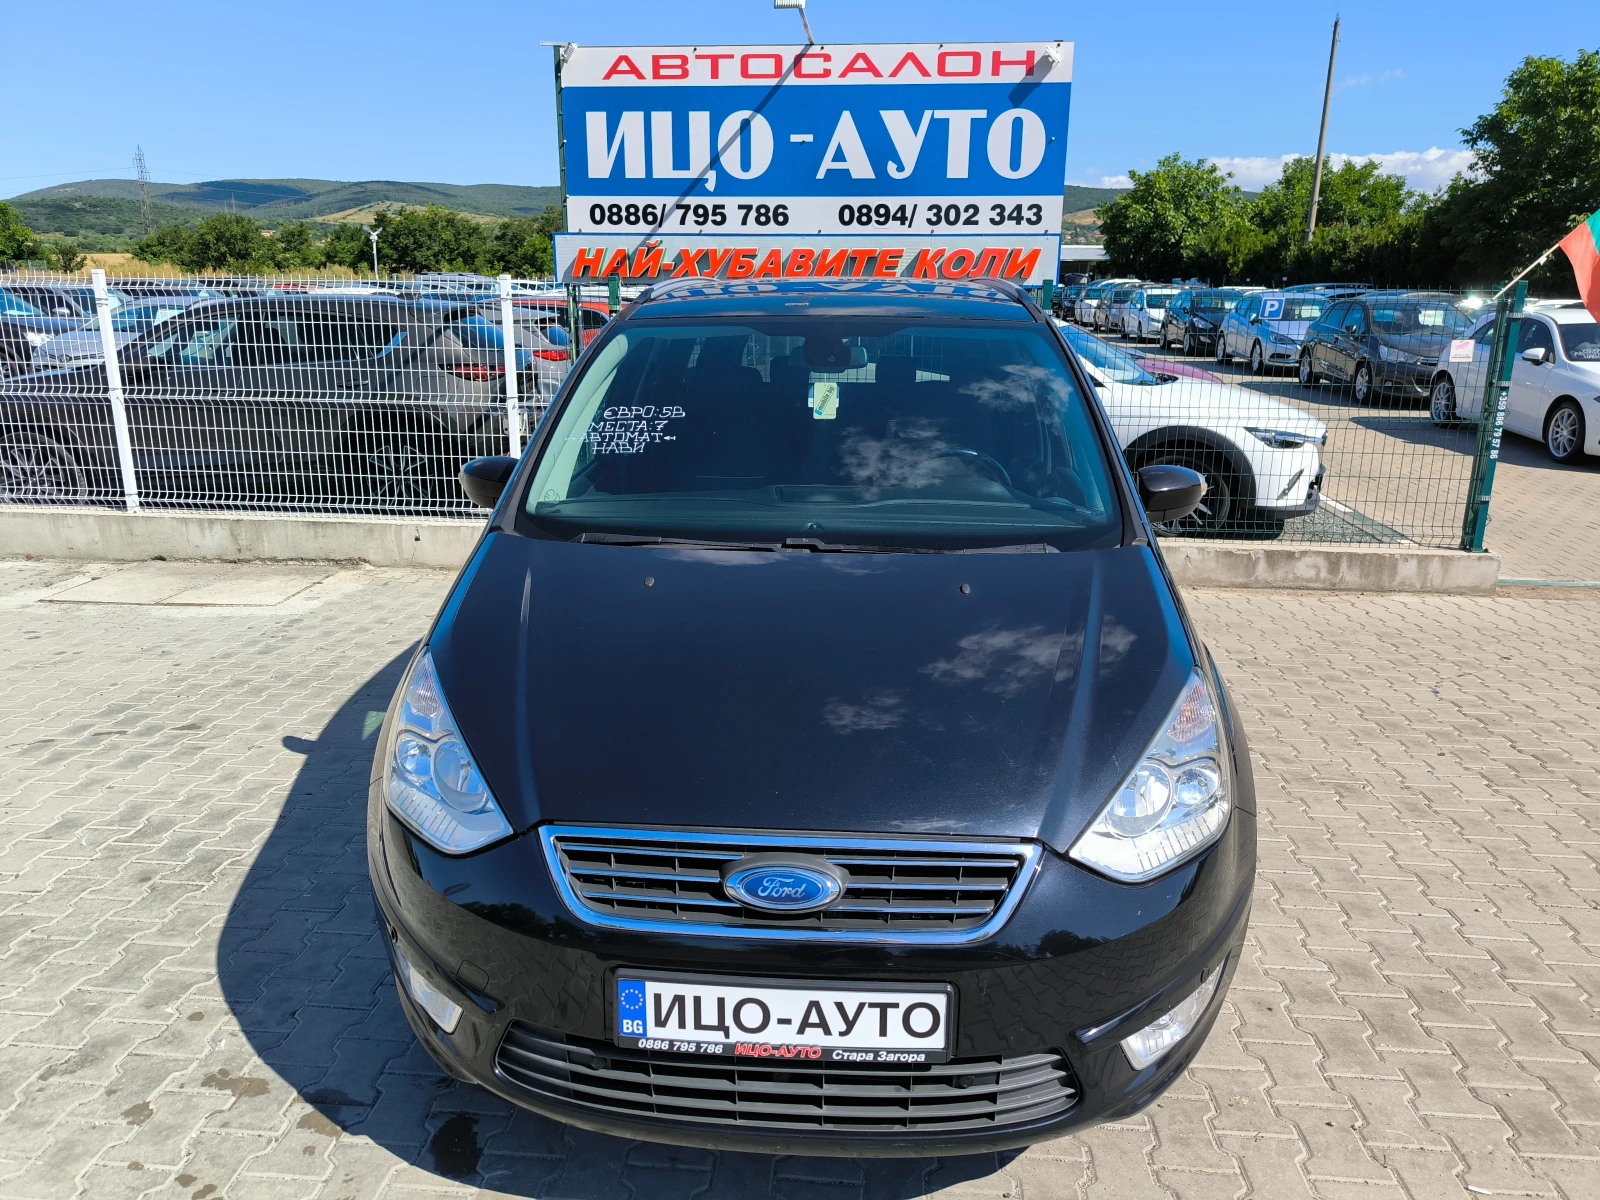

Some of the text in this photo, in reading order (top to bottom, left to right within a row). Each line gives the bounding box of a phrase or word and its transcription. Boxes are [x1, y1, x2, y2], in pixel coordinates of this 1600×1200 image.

[602, 50, 1036, 81] АВТОСАЛОН
[589, 203, 790, 228] 0886/ 795 786
[838, 203, 1043, 228] 0894/ 302 343
[571, 239, 1043, 279] НАЙ-ХУБАВИТЕ КОЛИ
[1264, 300, 1279, 317] P
[1498, 391, 1507, 410] +359
[1495, 411, 1505, 425] 886
[578, 432, 663, 443] АВТОМАТ
[1493, 428, 1502, 437] 79
[592, 442, 645, 454] НАВИ
[1492, 438, 1500, 448] 57
[757, 876, 806, 898] Ford
[653, 992, 941, 1040] ИЦО-АУТО
[622, 1018, 644, 1034] BG
[638, 1038, 926, 1062] 0886 795 786 ИЦО-АУТО Стара Загора
